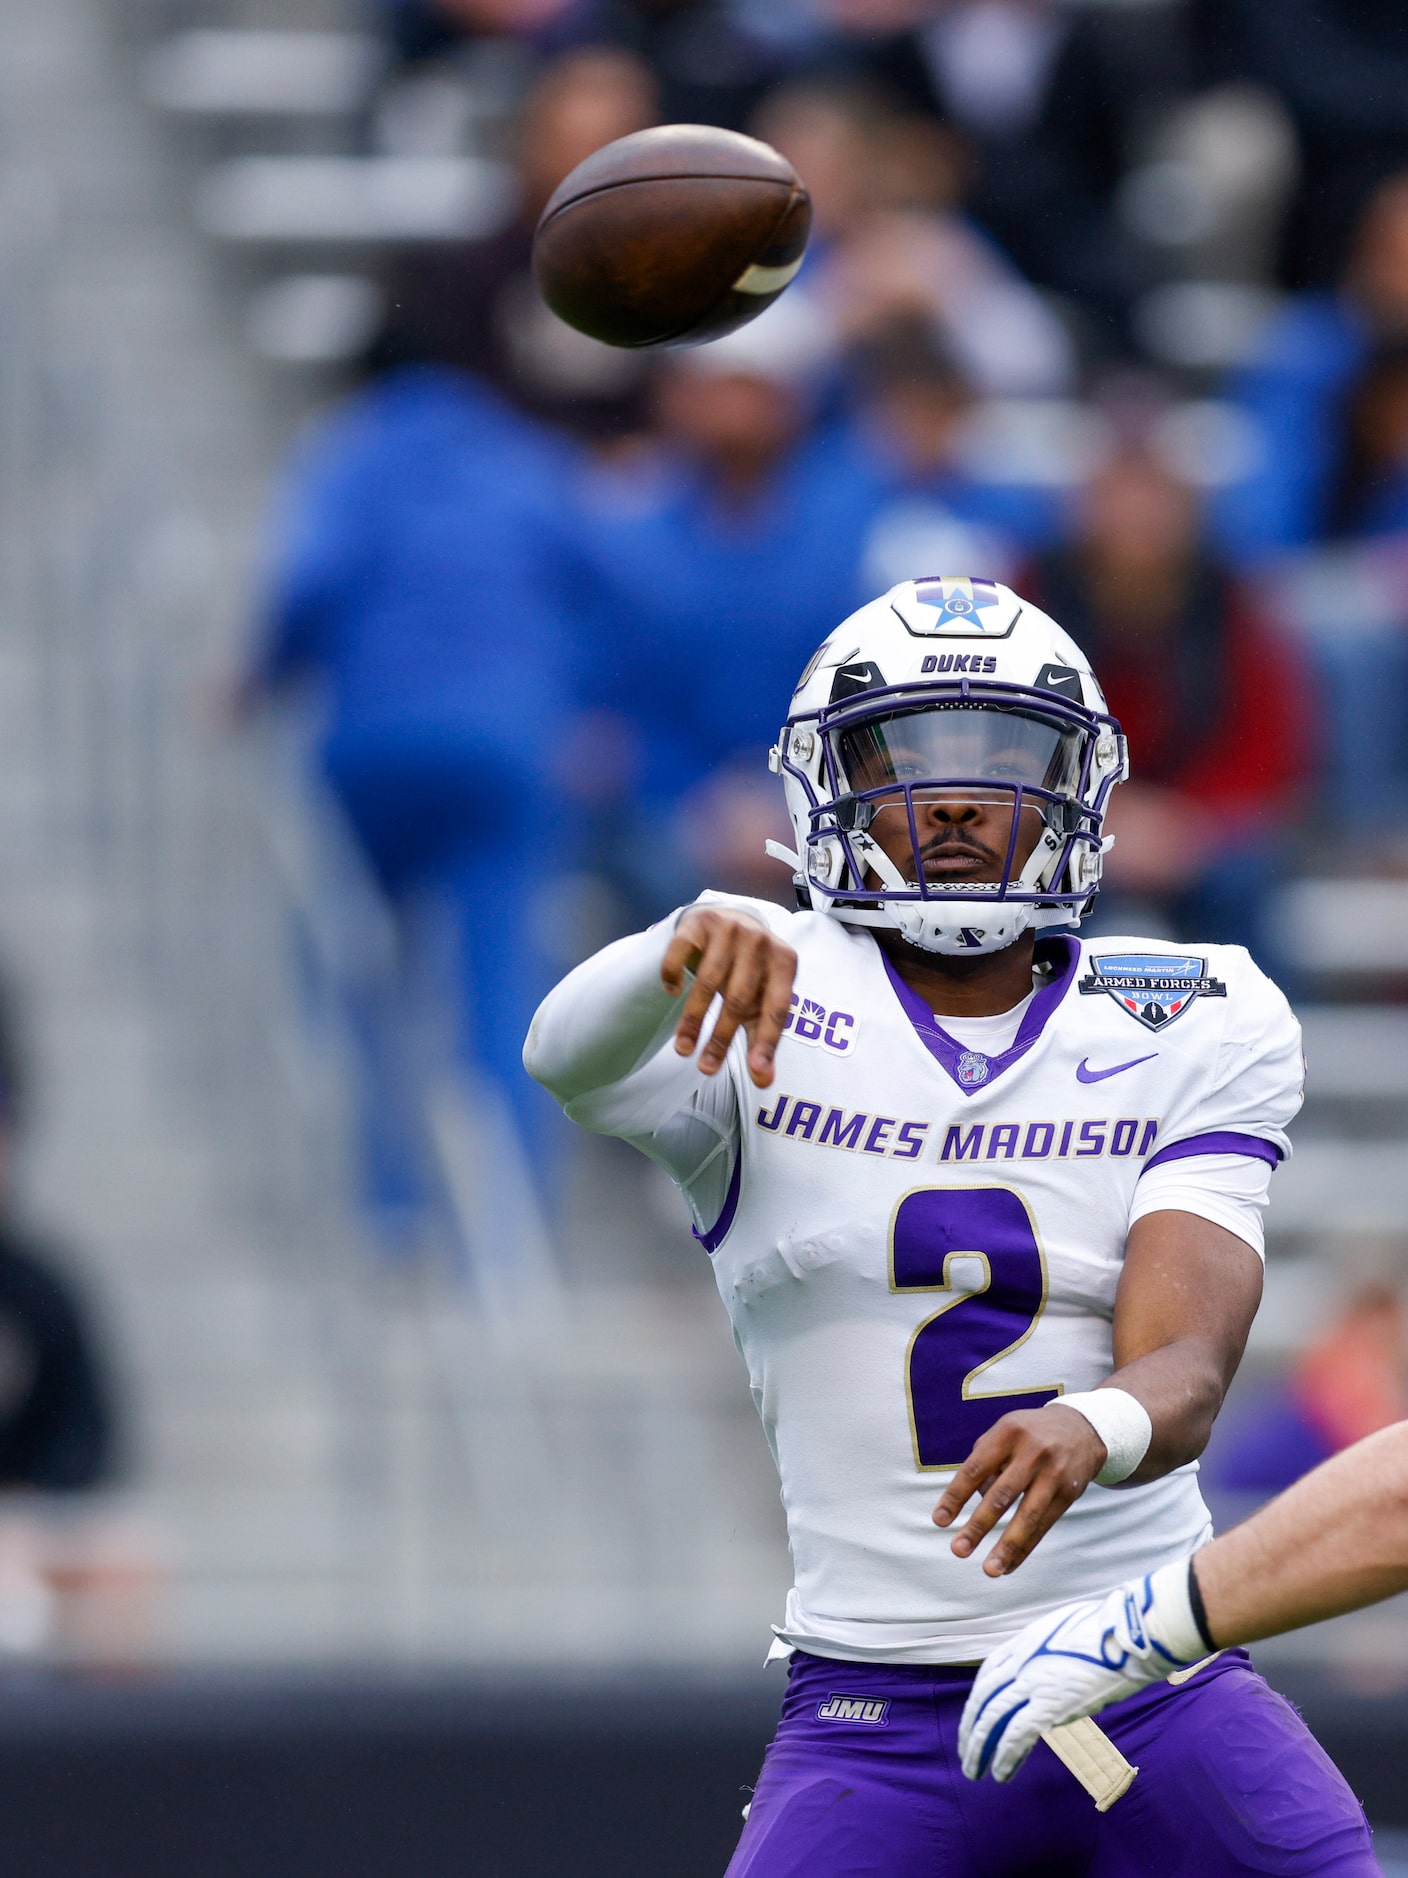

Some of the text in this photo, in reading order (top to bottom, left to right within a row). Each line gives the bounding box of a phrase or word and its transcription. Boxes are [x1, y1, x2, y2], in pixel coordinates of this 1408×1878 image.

[921, 654, 997, 673] DUKES
[1093, 977, 1211, 989] ARMED FORCES
[1131, 991, 1174, 1000] BOWL
[755, 1093, 930, 1162] JAMES
[887, 1183, 1065, 1473] 2
[819, 1697, 886, 1722] JMU
